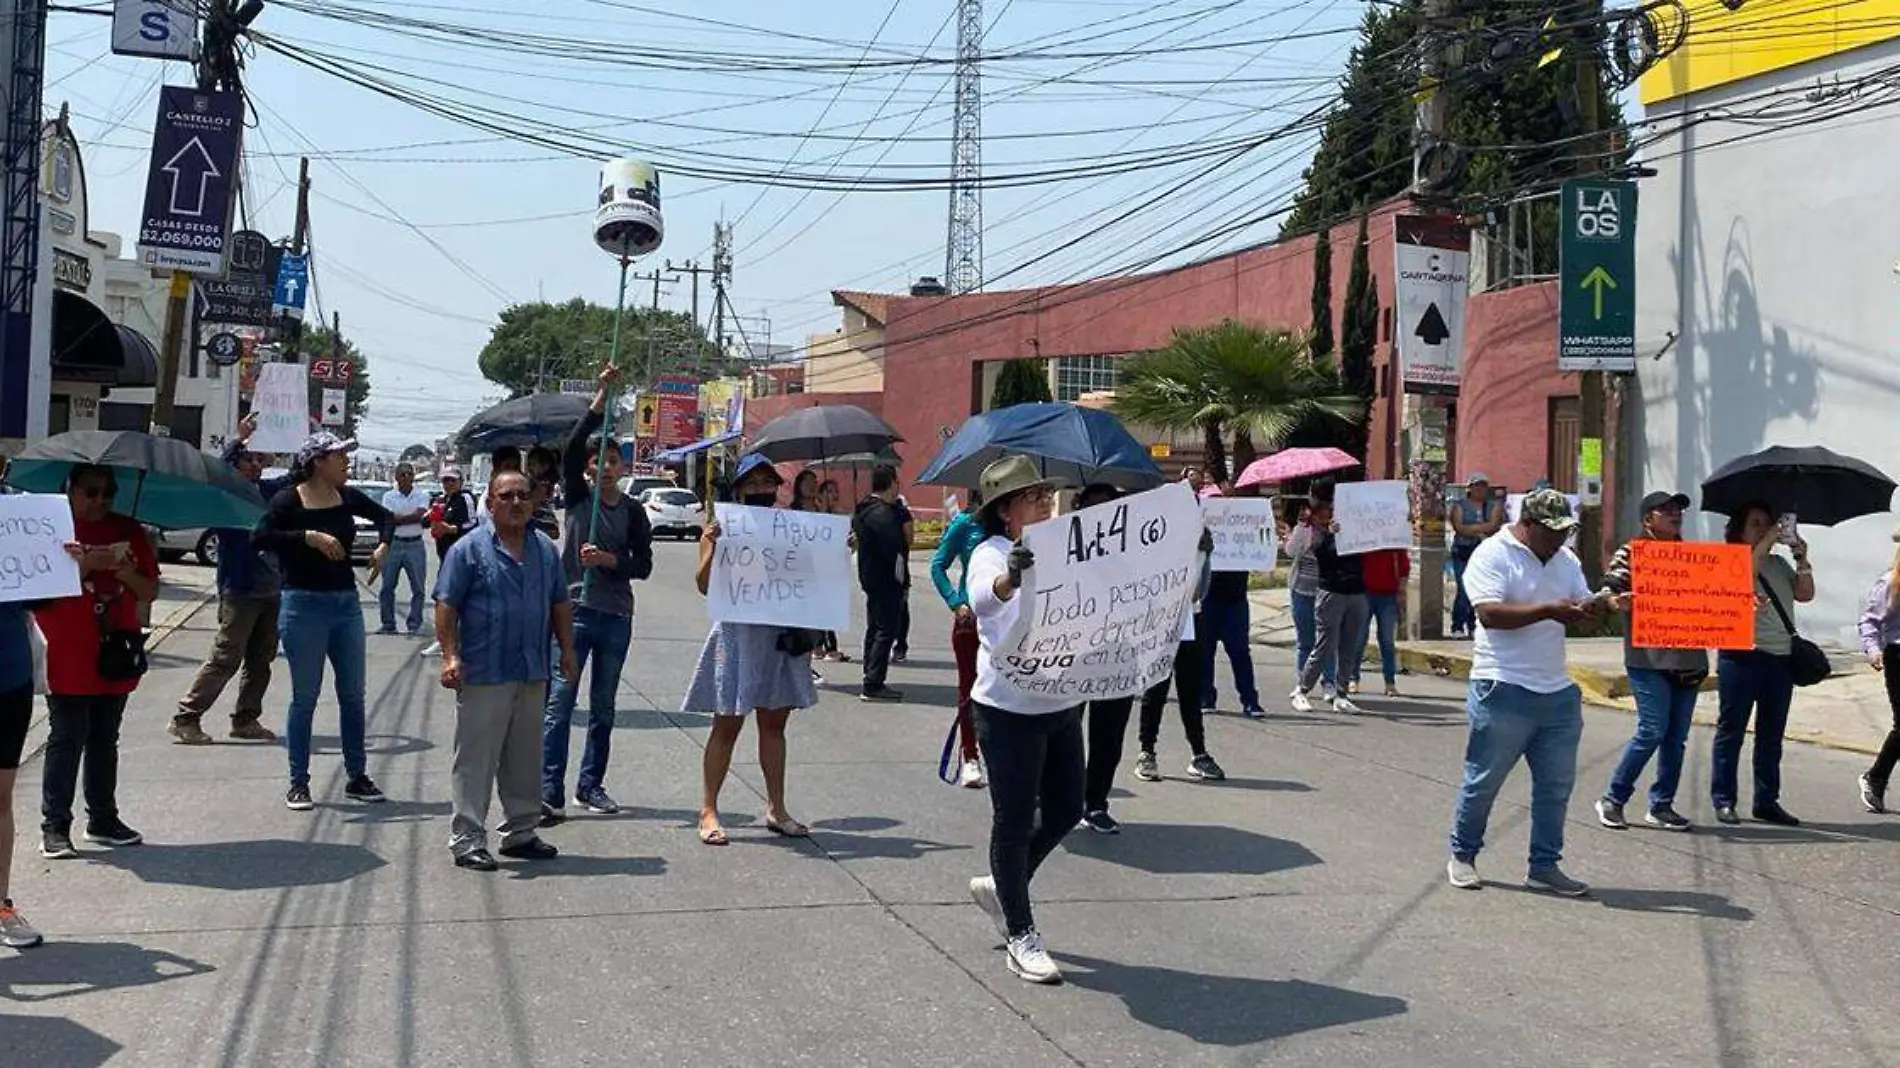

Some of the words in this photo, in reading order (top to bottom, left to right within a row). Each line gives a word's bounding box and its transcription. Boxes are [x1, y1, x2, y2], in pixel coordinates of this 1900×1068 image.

[140, 11, 170, 41] S
[165, 111, 223, 125] CASTELLO
[1578, 190, 1618, 212] LA
[147, 218, 182, 230] CASAS
[184, 223, 220, 234] DESDE
[1577, 212, 1620, 237] OS
[1400, 270, 1466, 283] CARTAGENA
[1562, 336, 1633, 346] WHATSAPP
[726, 512, 752, 538] EL
[772, 510, 832, 547] Agua
[1139, 515, 1167, 547] (6)
[719, 545, 754, 567] NO
[761, 547, 797, 572] SE
[728, 577, 806, 606] VENDE
[1037, 582, 1096, 628] Toda
[1109, 565, 1189, 613] persona
[1006, 653, 1075, 675] agua
[1084, 650, 1107, 665] en
